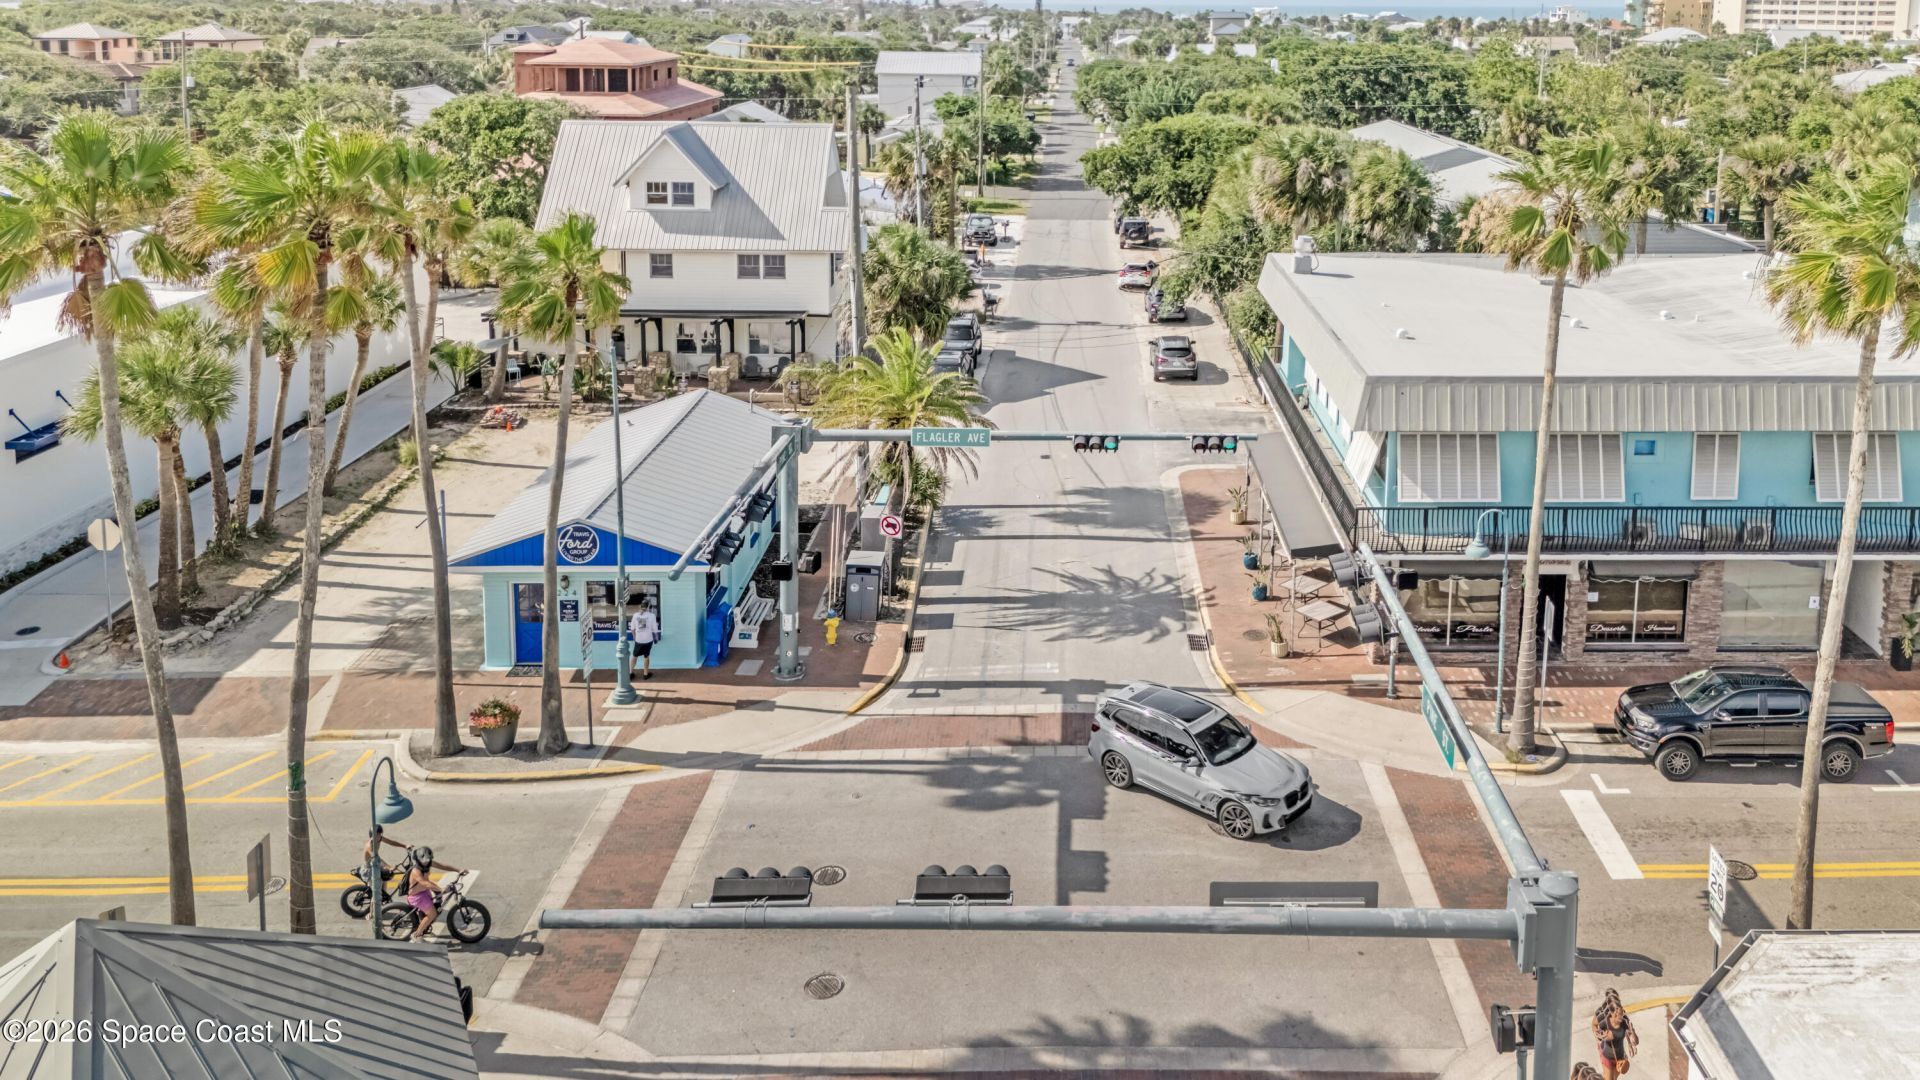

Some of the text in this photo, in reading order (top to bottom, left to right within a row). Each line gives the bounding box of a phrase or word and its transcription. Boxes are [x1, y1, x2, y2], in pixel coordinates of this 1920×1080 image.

[916, 432, 986, 443] FLAGLER AVE
[559, 527, 594, 549] Ford
[1455, 624, 1495, 633] Pasta
[1589, 624, 1627, 632] Desserts
[582, 627, 593, 647] 20
[1710, 873, 1724, 902] 20
